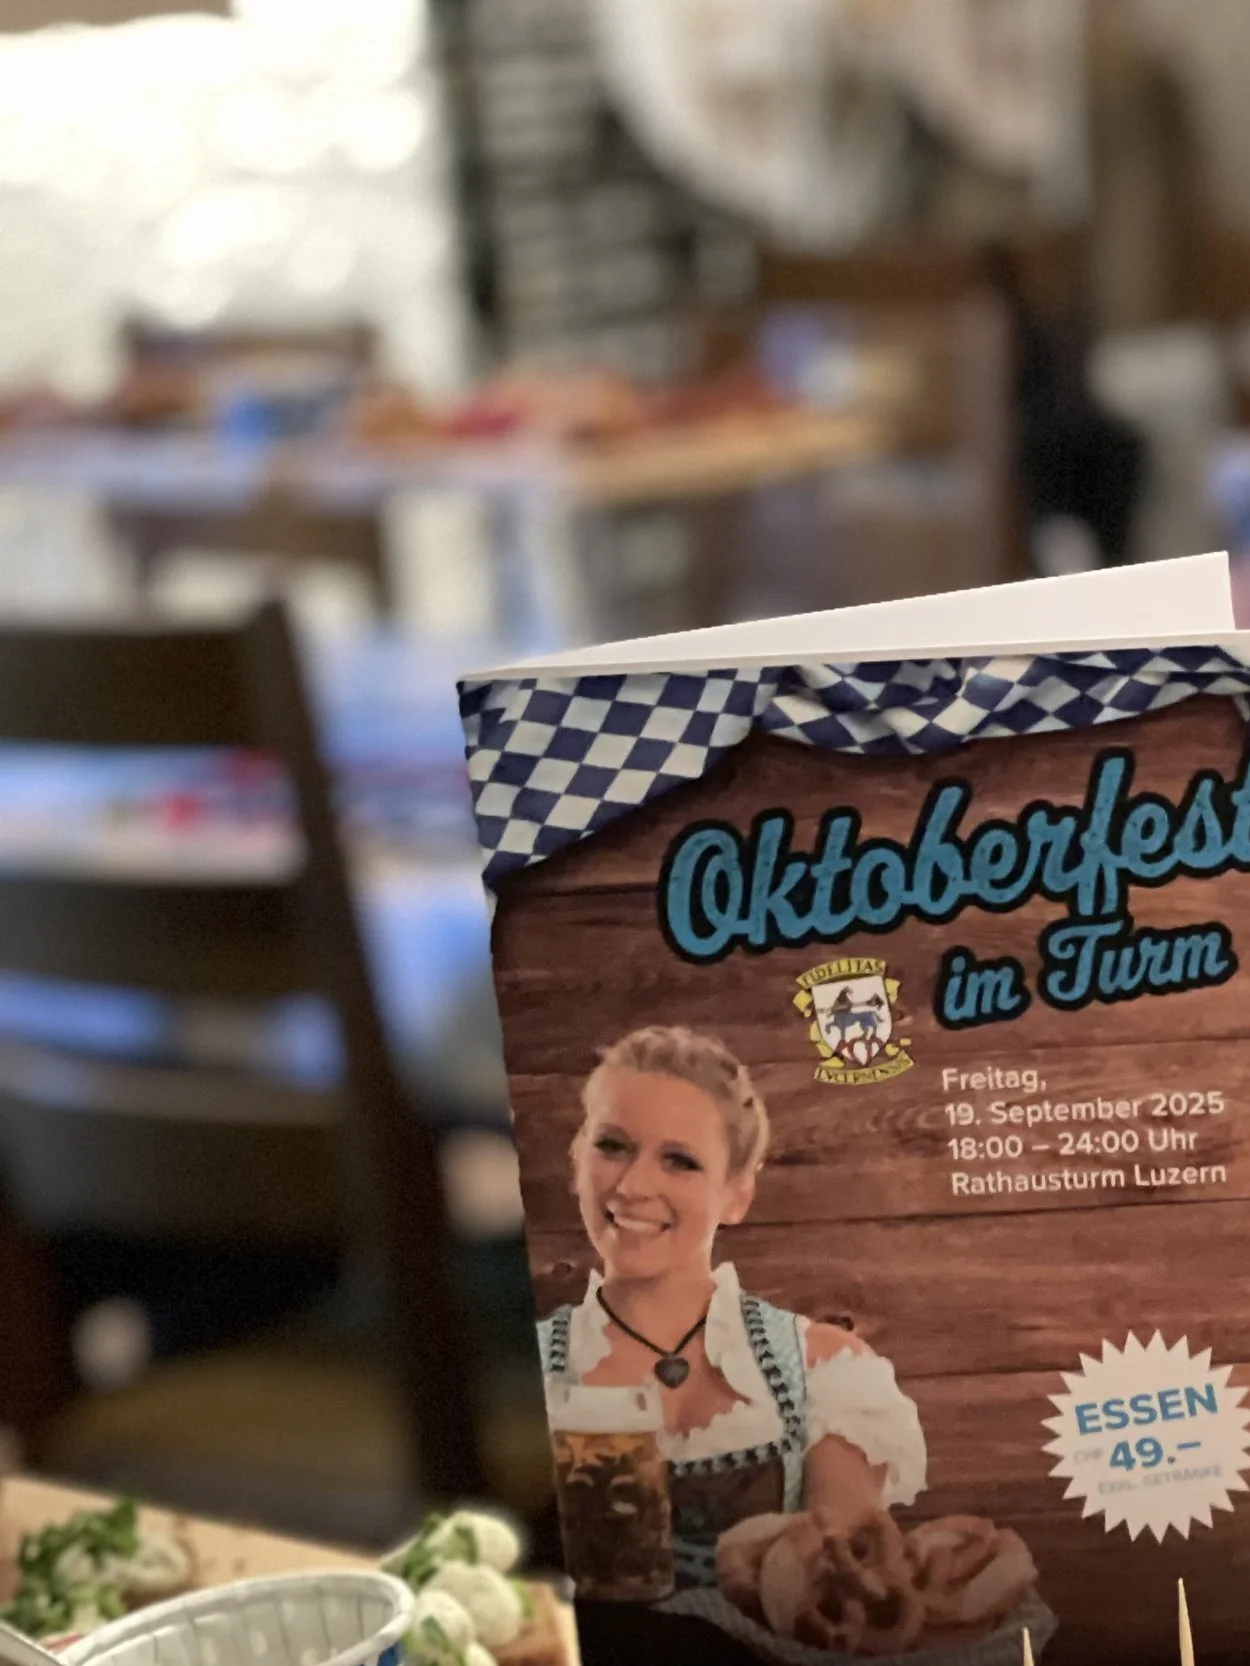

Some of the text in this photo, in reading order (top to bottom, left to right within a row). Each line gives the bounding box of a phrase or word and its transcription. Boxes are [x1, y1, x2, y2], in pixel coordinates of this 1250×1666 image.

[942, 918, 1232, 1024] im Turm
[942, 1066, 1046, 1093] Freitag,
[944, 1091, 1225, 1127] 19. September 2025
[948, 1135, 1023, 1160] 18:00
[1057, 1130, 1140, 1156] 24:00
[1148, 1128, 1198, 1151] Uhr
[951, 1164, 1227, 1195] Rathausturm Luzern
[1074, 1383, 1219, 1435] ESSEN
